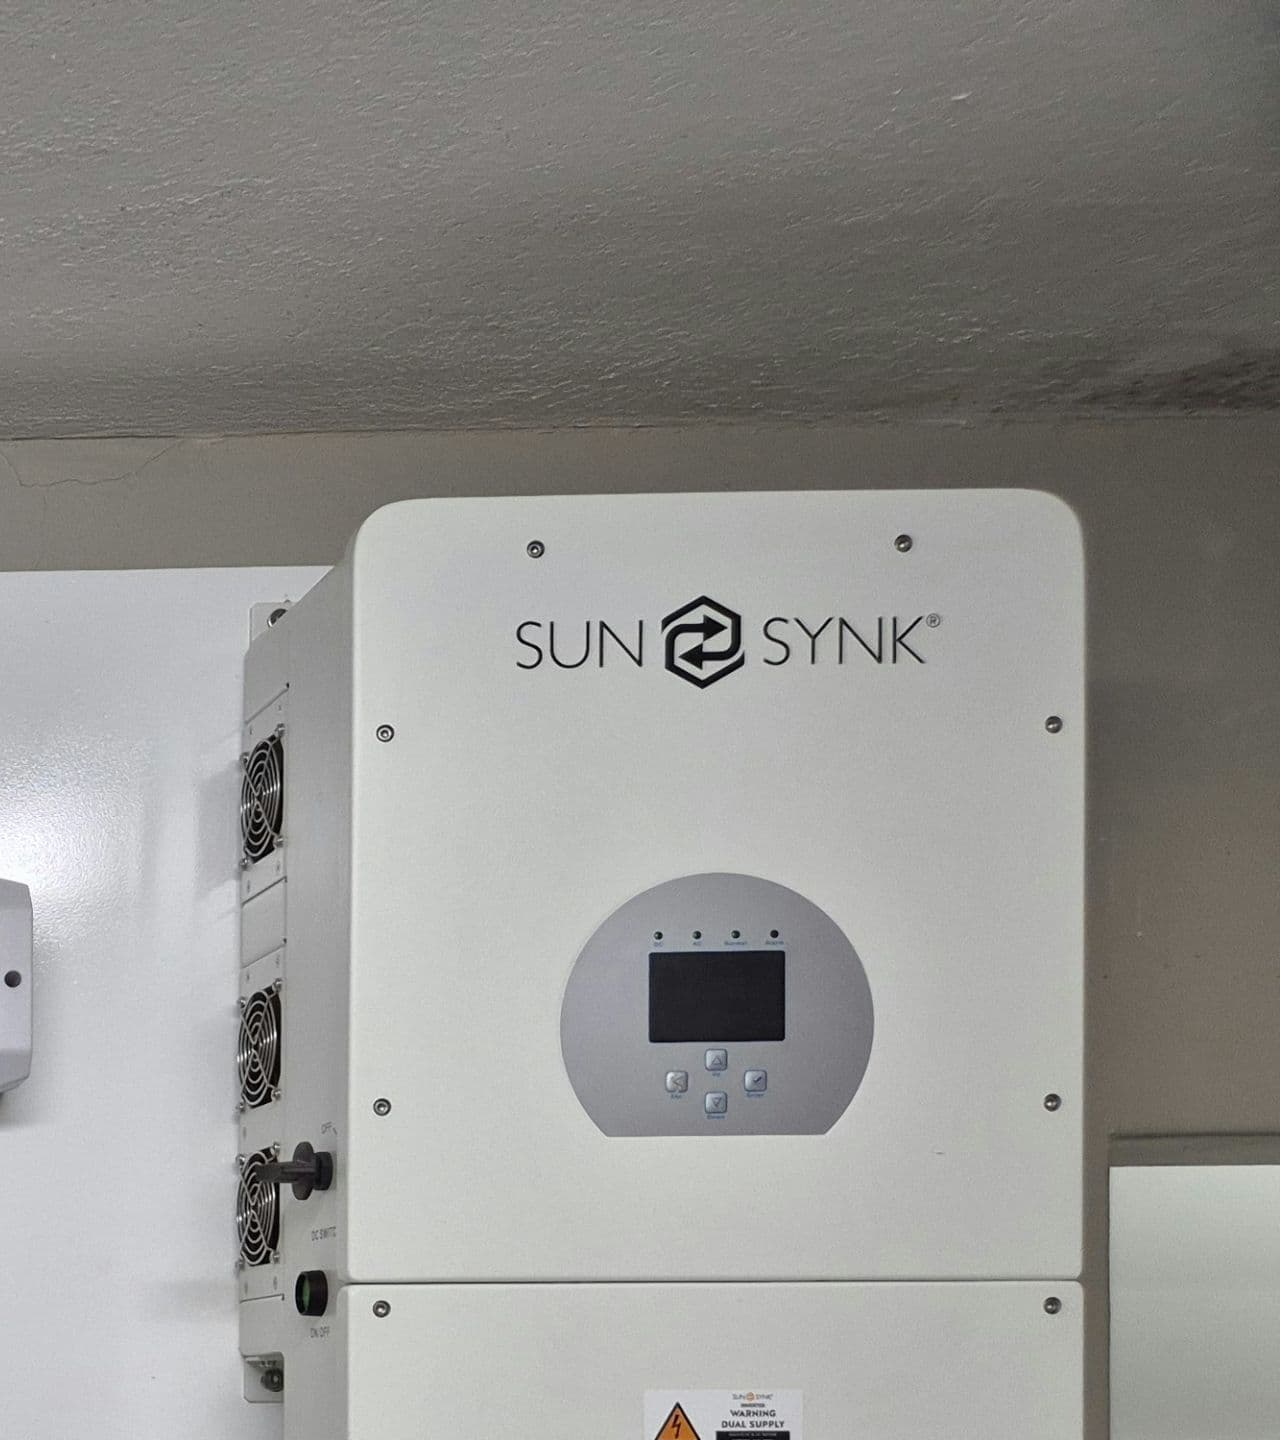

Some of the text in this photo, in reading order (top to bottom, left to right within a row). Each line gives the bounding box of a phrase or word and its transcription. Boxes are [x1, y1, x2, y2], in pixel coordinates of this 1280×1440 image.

[515, 619, 644, 669] SUN
[729, 1409, 777, 1418] WARNING
[721, 1420, 785, 1429] DUAL SUPPLY
